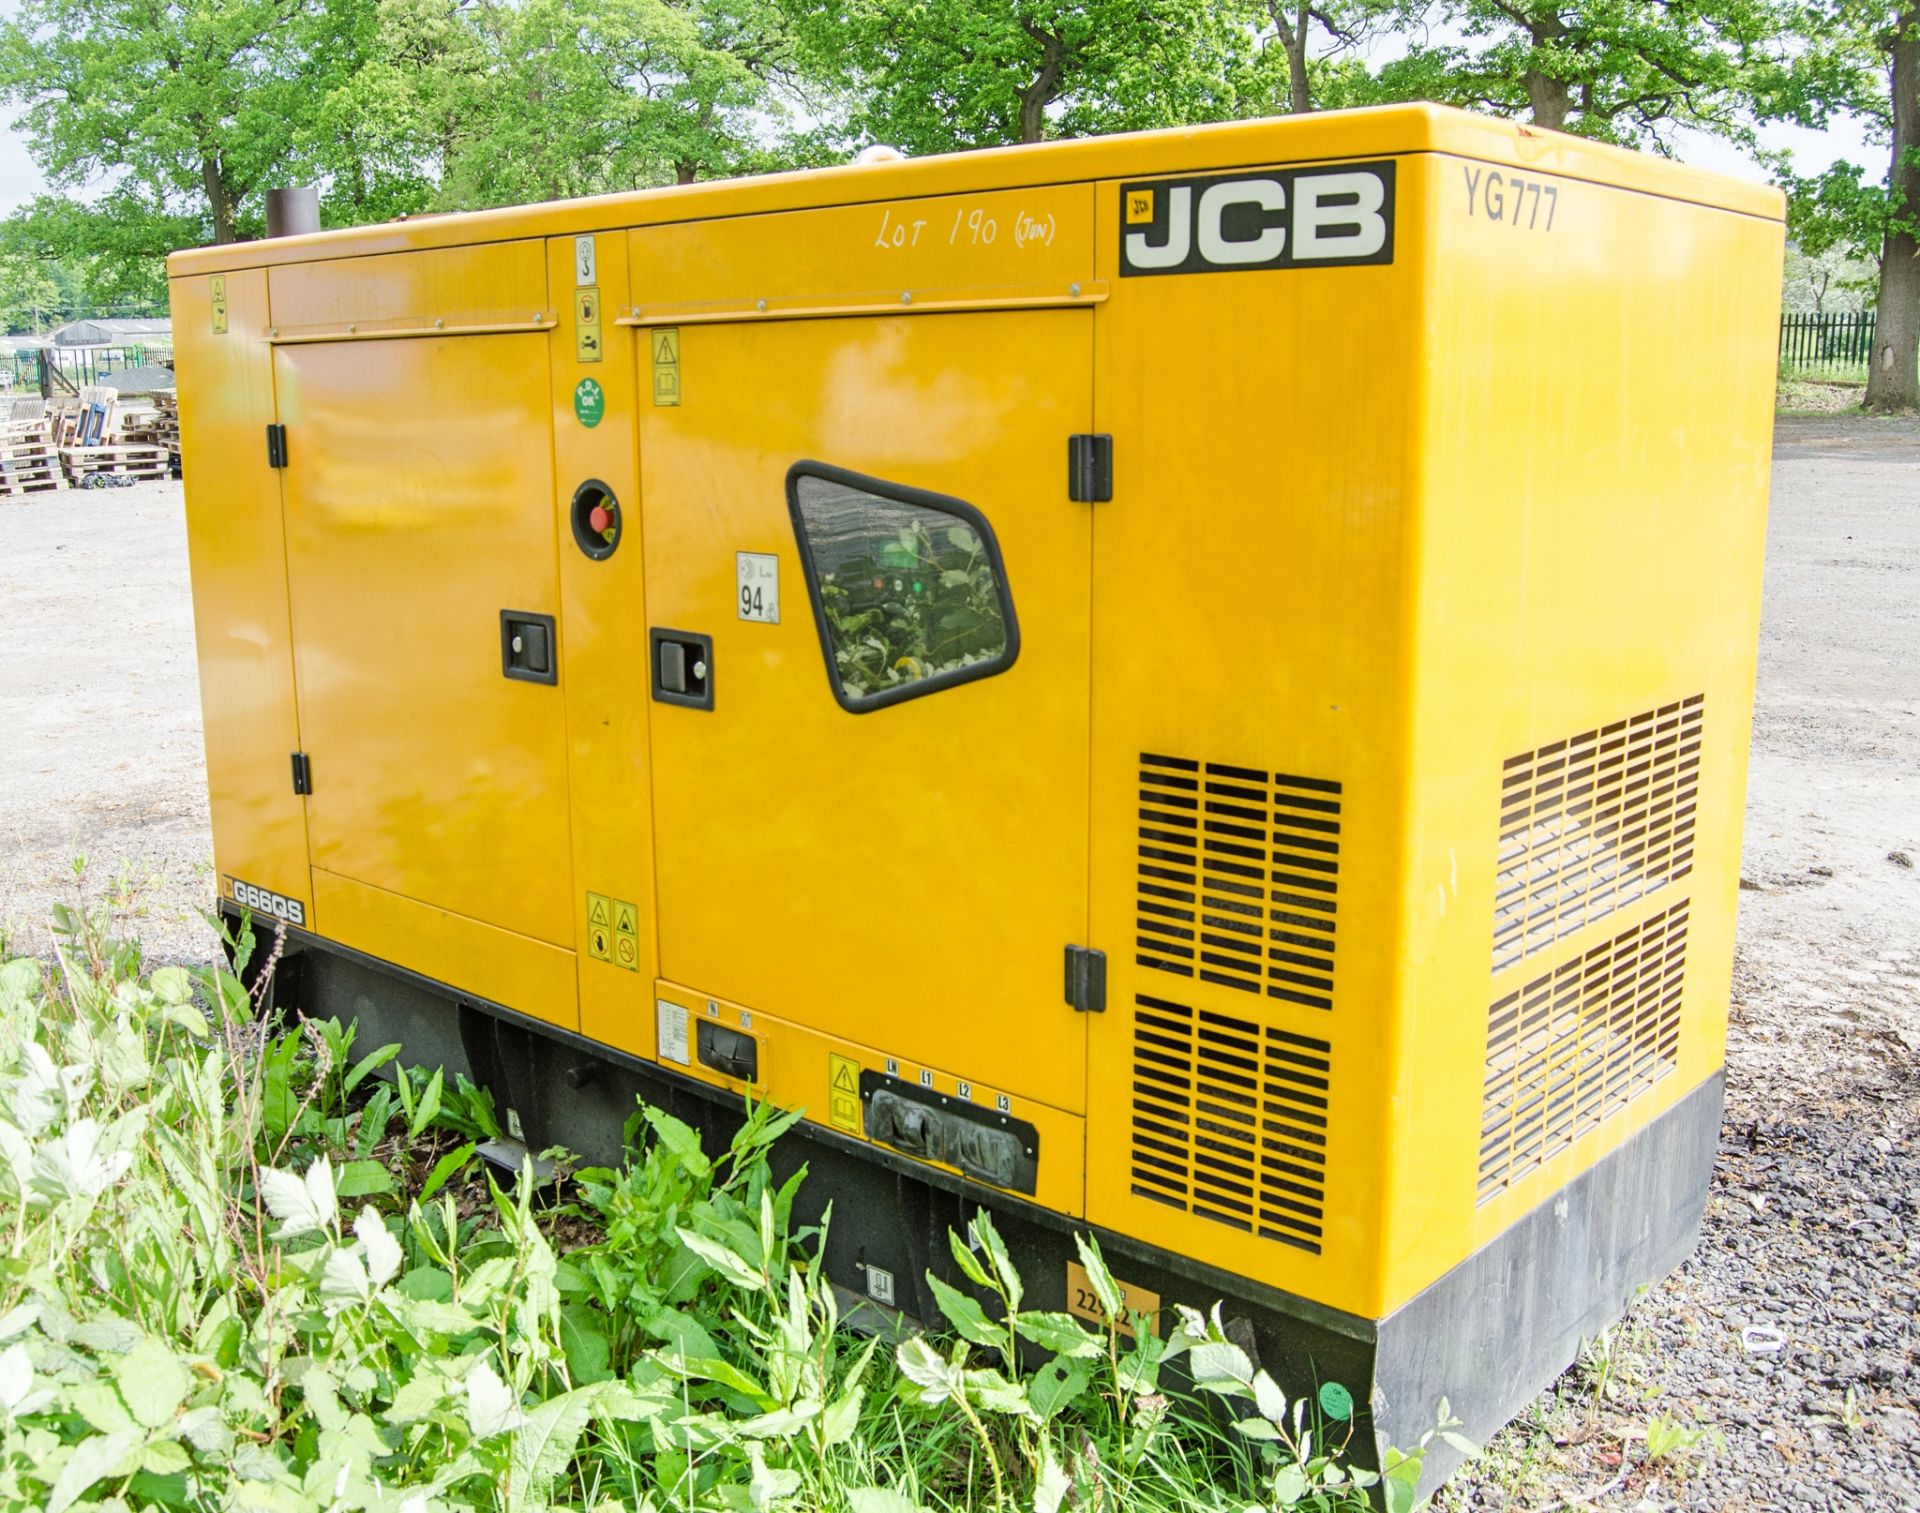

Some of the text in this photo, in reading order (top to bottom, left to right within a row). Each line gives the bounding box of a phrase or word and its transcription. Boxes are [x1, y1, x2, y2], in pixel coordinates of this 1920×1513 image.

[1464, 166, 1557, 232] YG777
[949, 209, 997, 244] 190
[1126, 171, 1386, 268] JCB
[582, 396, 595, 406] OK
[742, 585, 763, 616] 94
[921, 1071, 931, 1085] L1
[959, 1083, 970, 1098] L2
[998, 1095, 1009, 1111] L3
